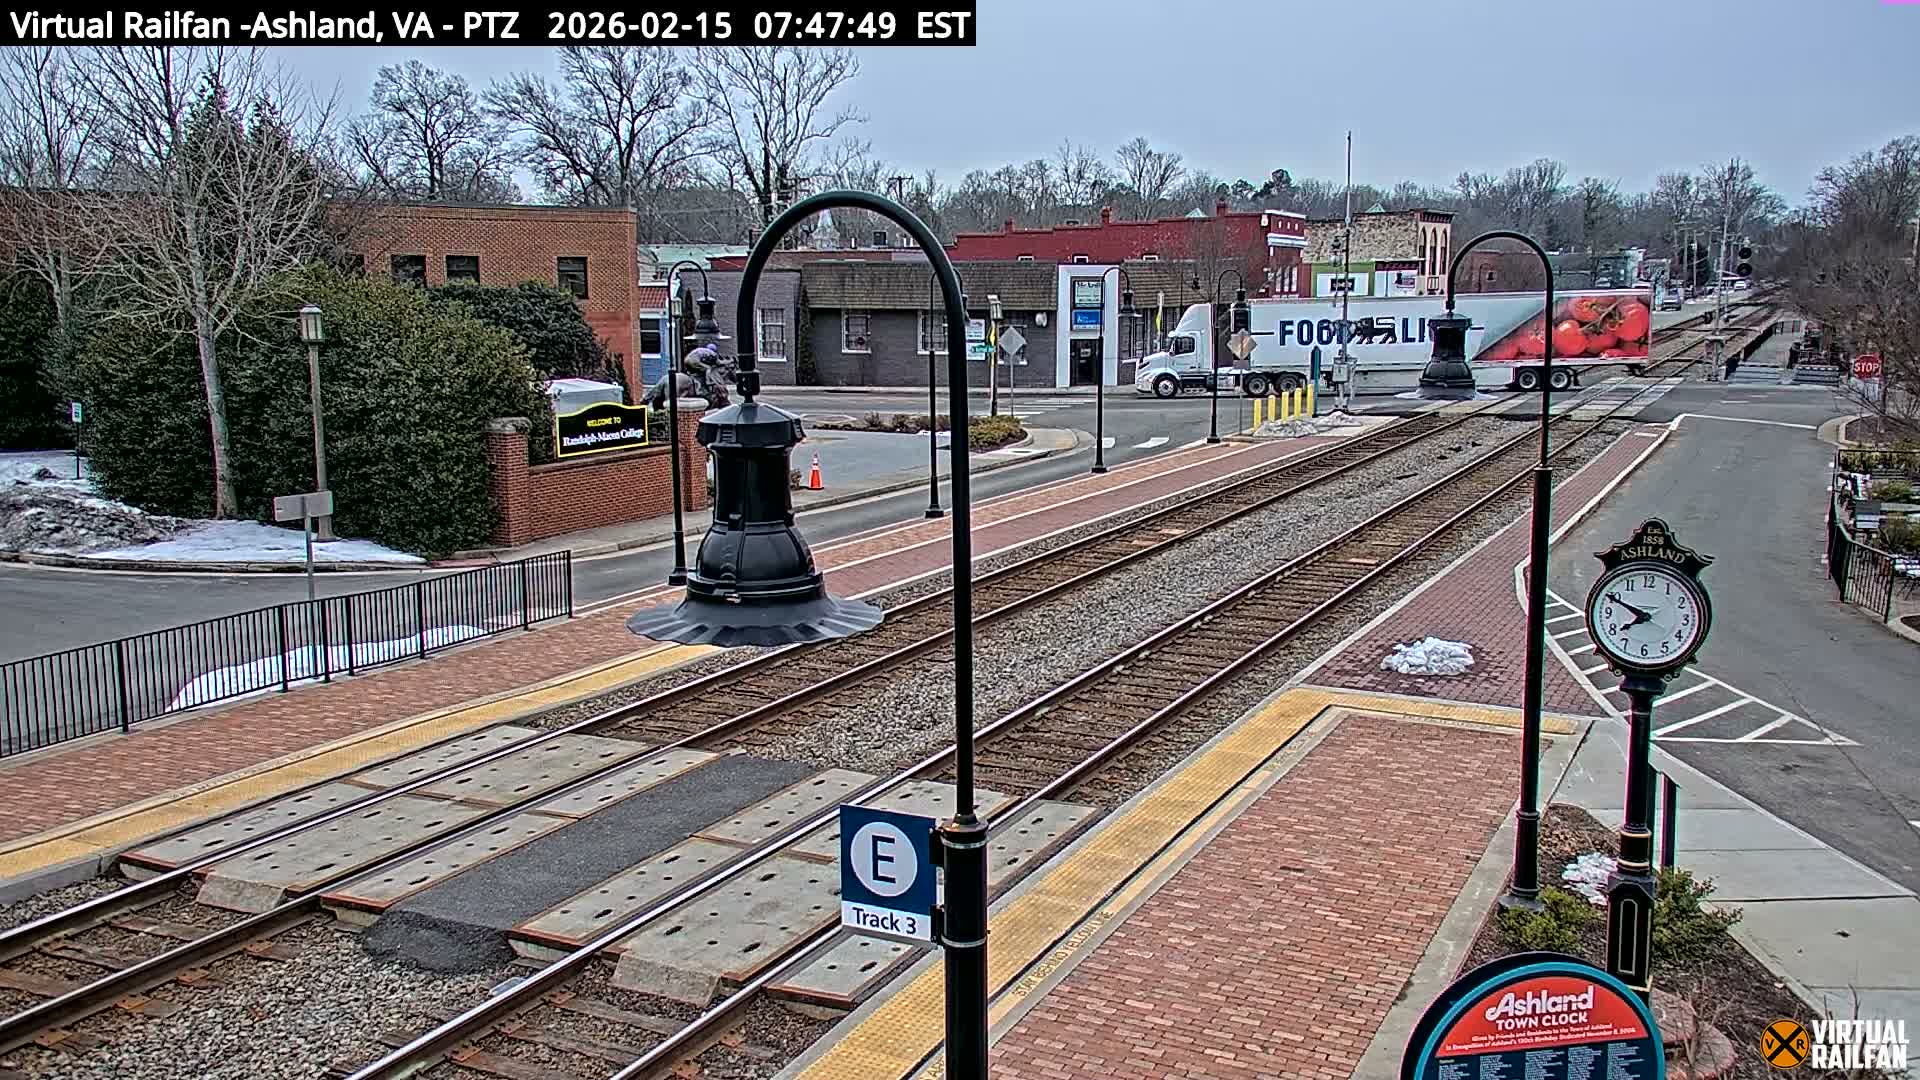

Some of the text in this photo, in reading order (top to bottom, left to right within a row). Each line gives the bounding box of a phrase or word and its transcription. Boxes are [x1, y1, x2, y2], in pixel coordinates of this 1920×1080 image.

[1402, 317, 1427, 344] LI
[1855, 361, 1879, 373] STOP
[587, 416, 621, 427] WELCOME TO
[562, 427, 645, 446] Randolph-Macon College
[1643, 536, 1664, 545] 1858
[1621, 546, 1685, 564] ASHLAND
[1625, 580, 1634, 591] 11
[1643, 576, 1656, 588] 12
[1665, 583, 1671, 595] 1
[1679, 597, 1686, 609] 2
[1605, 607, 1612, 619] 9
[1682, 615, 1689, 626] 3
[1609, 623, 1617, 635] 8
[1675, 629, 1683, 642] 4
[1620, 638, 1629, 651] 7
[1641, 644, 1648, 656] 6
[1660, 641, 1669, 654] 5
[872, 834, 896, 884] E
[852, 907, 916, 935] Track 3
[1485, 984, 1594, 1021] Ashland
[1496, 1011, 1588, 1031] TOWN CLOCK
[1496, 1032, 1515, 1040] Friends
